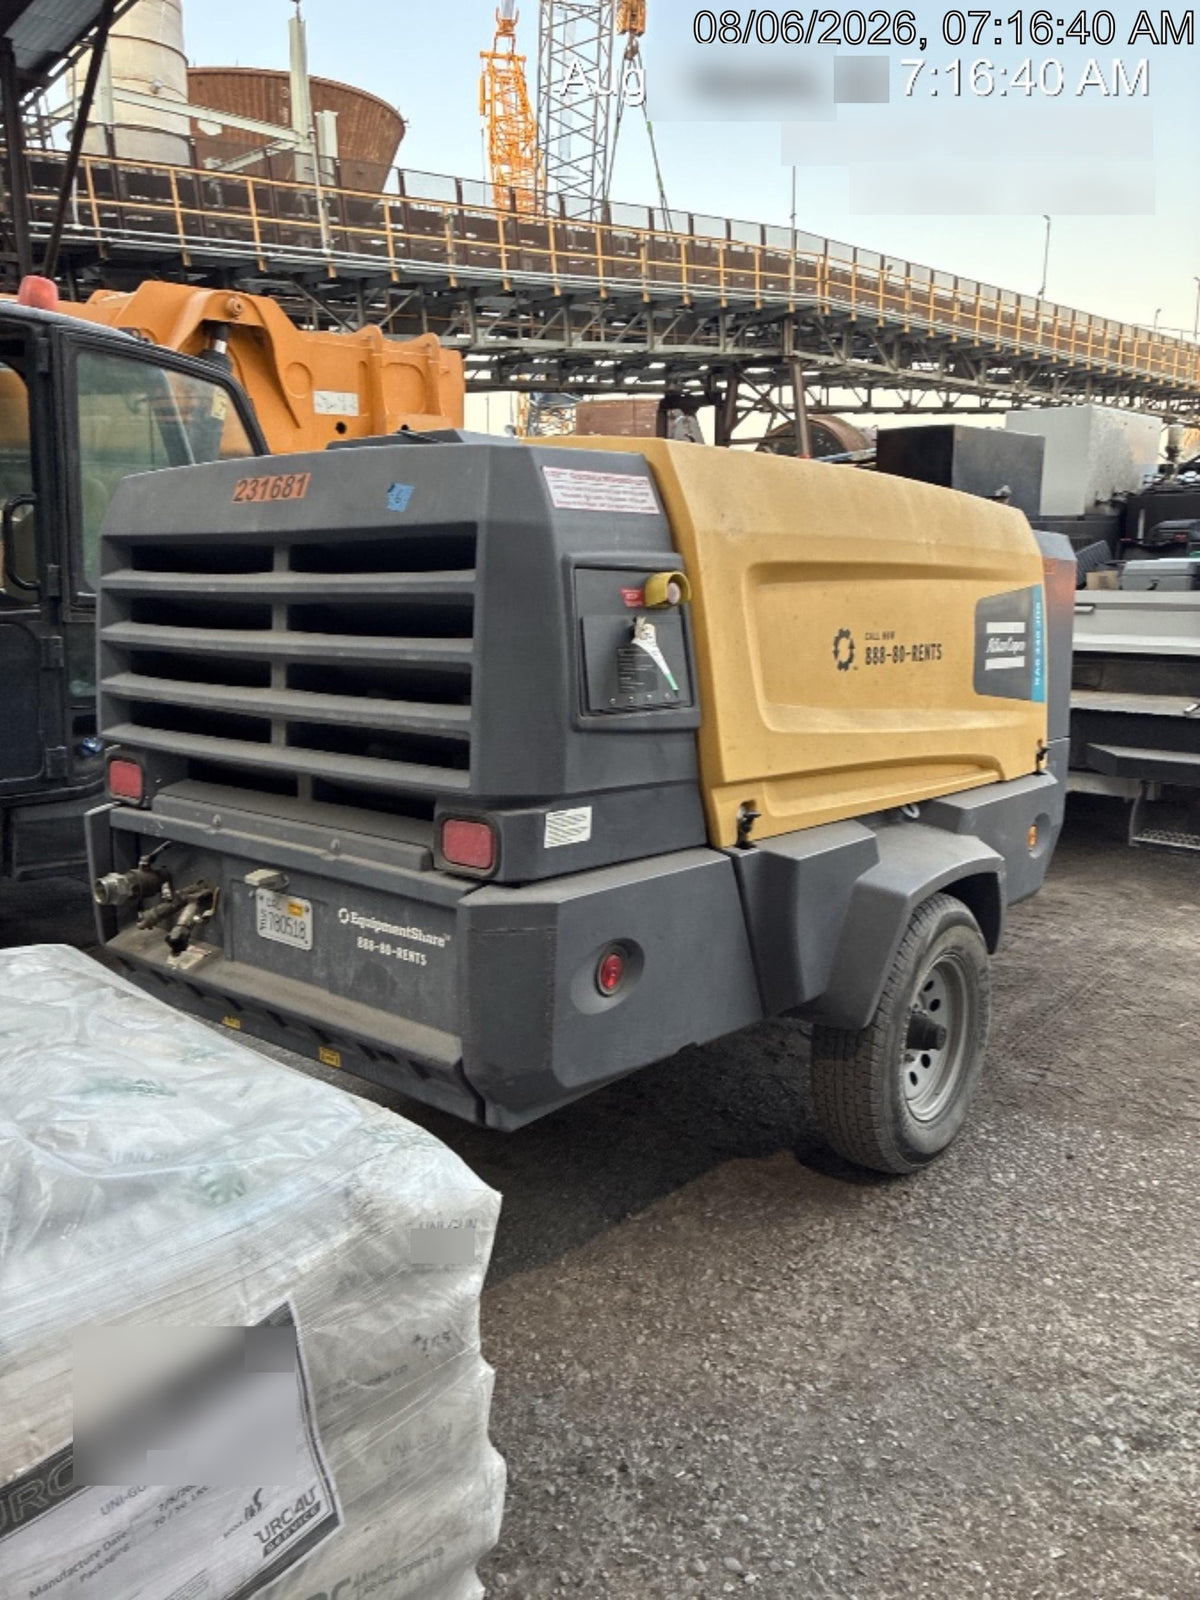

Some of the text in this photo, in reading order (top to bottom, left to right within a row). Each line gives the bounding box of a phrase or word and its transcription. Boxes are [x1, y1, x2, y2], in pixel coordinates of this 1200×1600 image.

[233, 474, 308, 502] 231681
[865, 643, 943, 665] 888-80-RENTS
[357, 935, 428, 967] 888-80-RENTS
